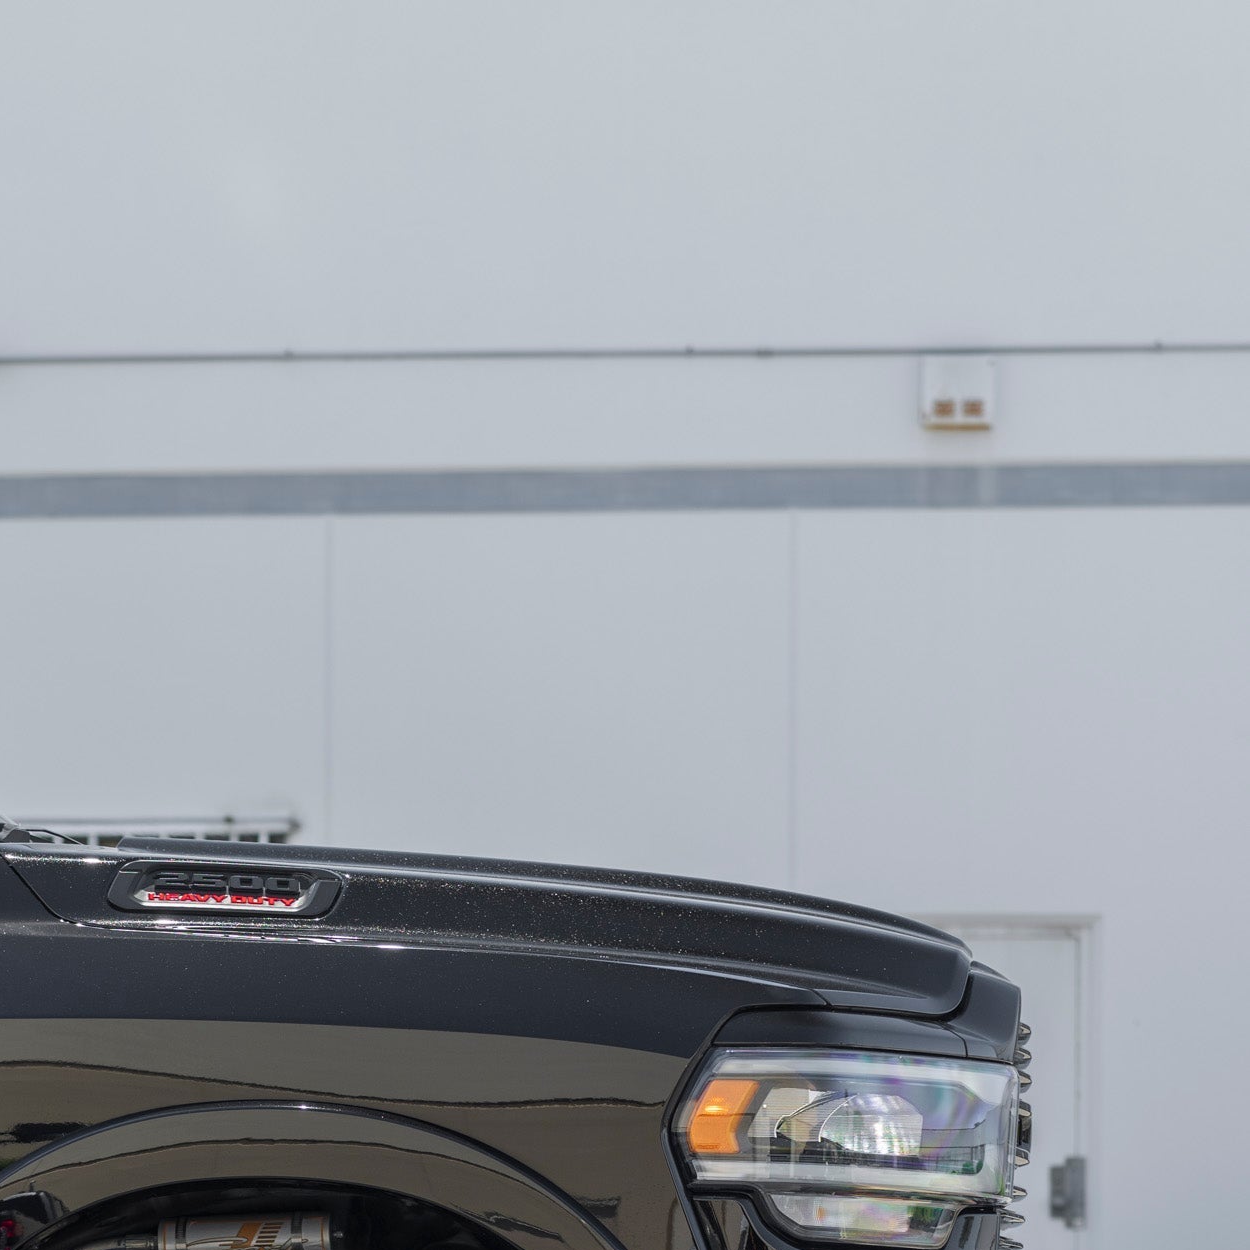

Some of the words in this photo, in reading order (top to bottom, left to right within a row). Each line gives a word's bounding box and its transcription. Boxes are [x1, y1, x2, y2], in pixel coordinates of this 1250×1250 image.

[153, 872, 299, 894] 2500
[148, 892, 227, 904] HEAVY
[231, 894, 295, 907] DUTY
